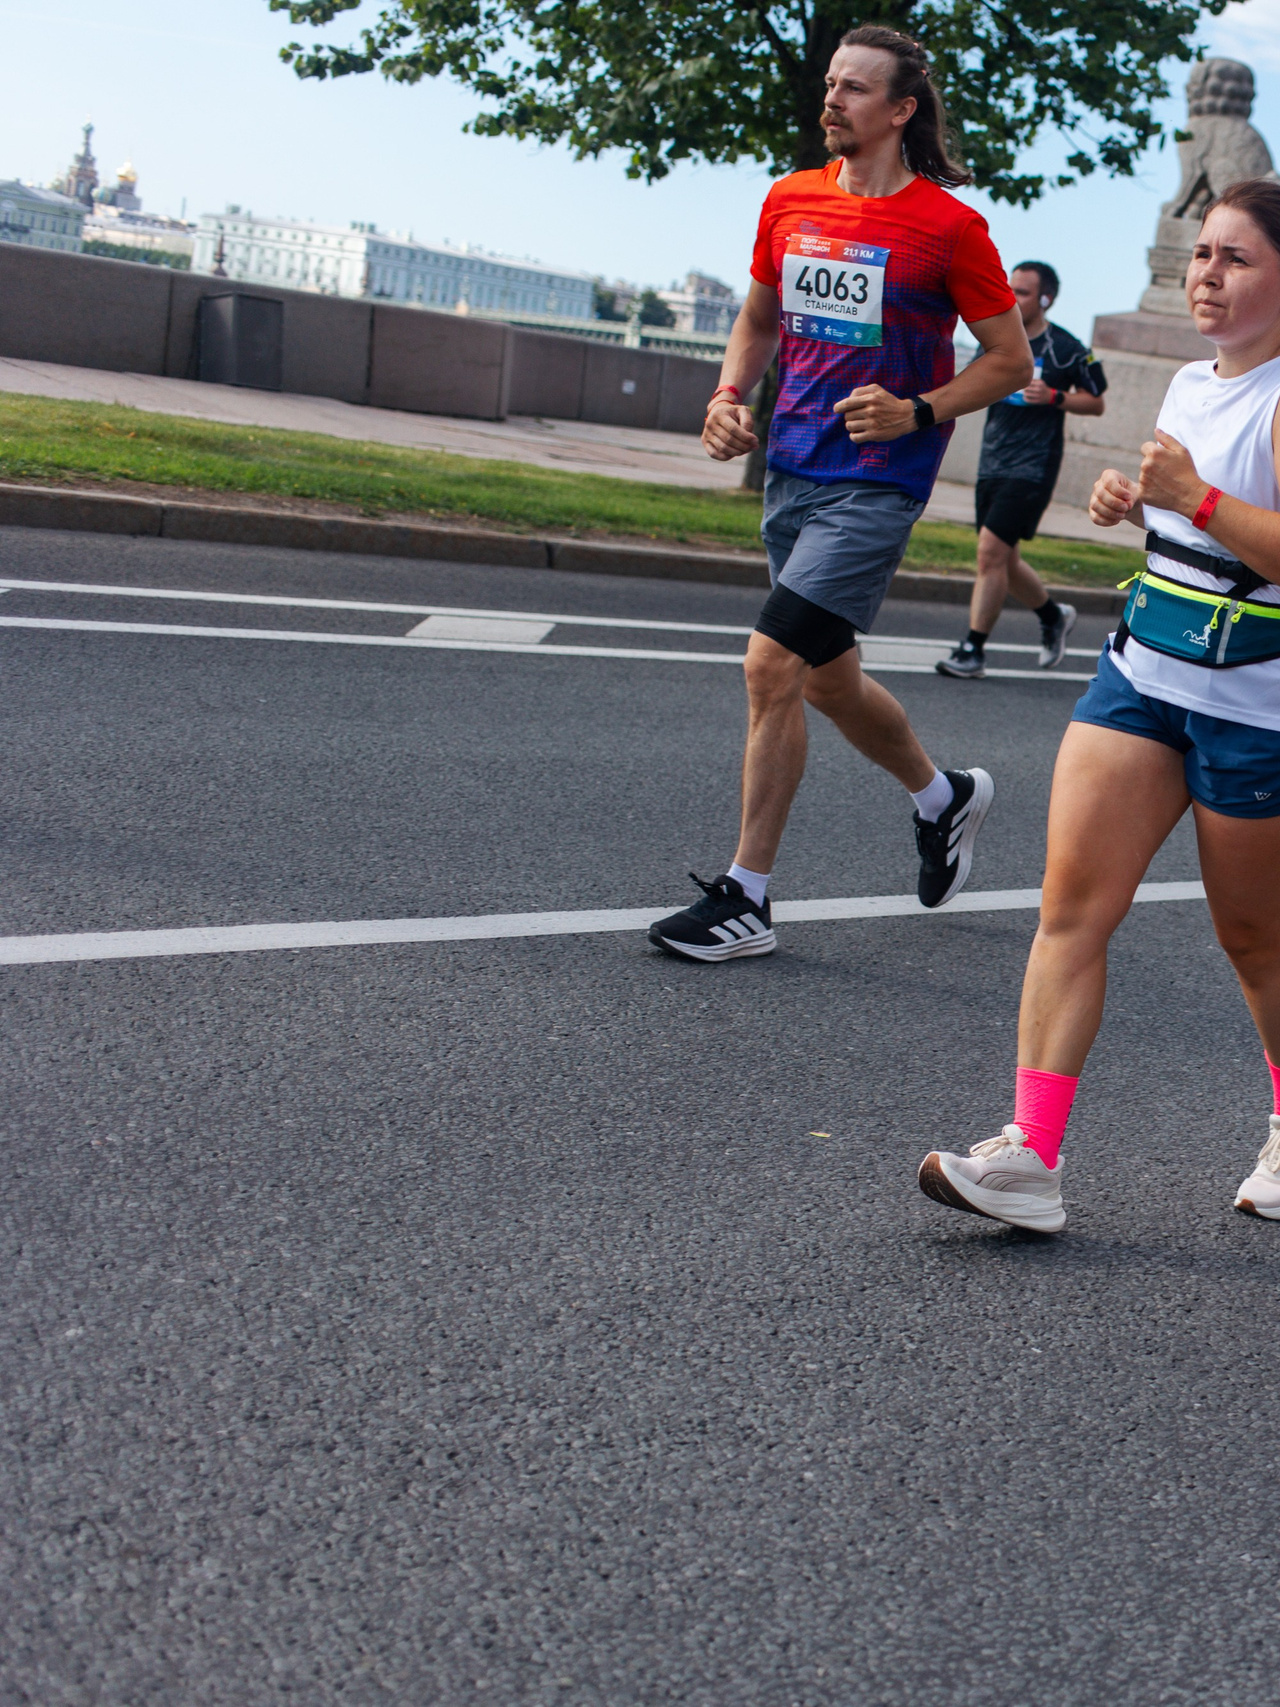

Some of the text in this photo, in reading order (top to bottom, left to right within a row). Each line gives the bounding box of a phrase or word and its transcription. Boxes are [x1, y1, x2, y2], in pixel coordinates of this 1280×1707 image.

[795, 265, 869, 304] 4063
[805, 299, 858, 316] СТАНИСЛАВ
[792, 316, 803, 333] E
